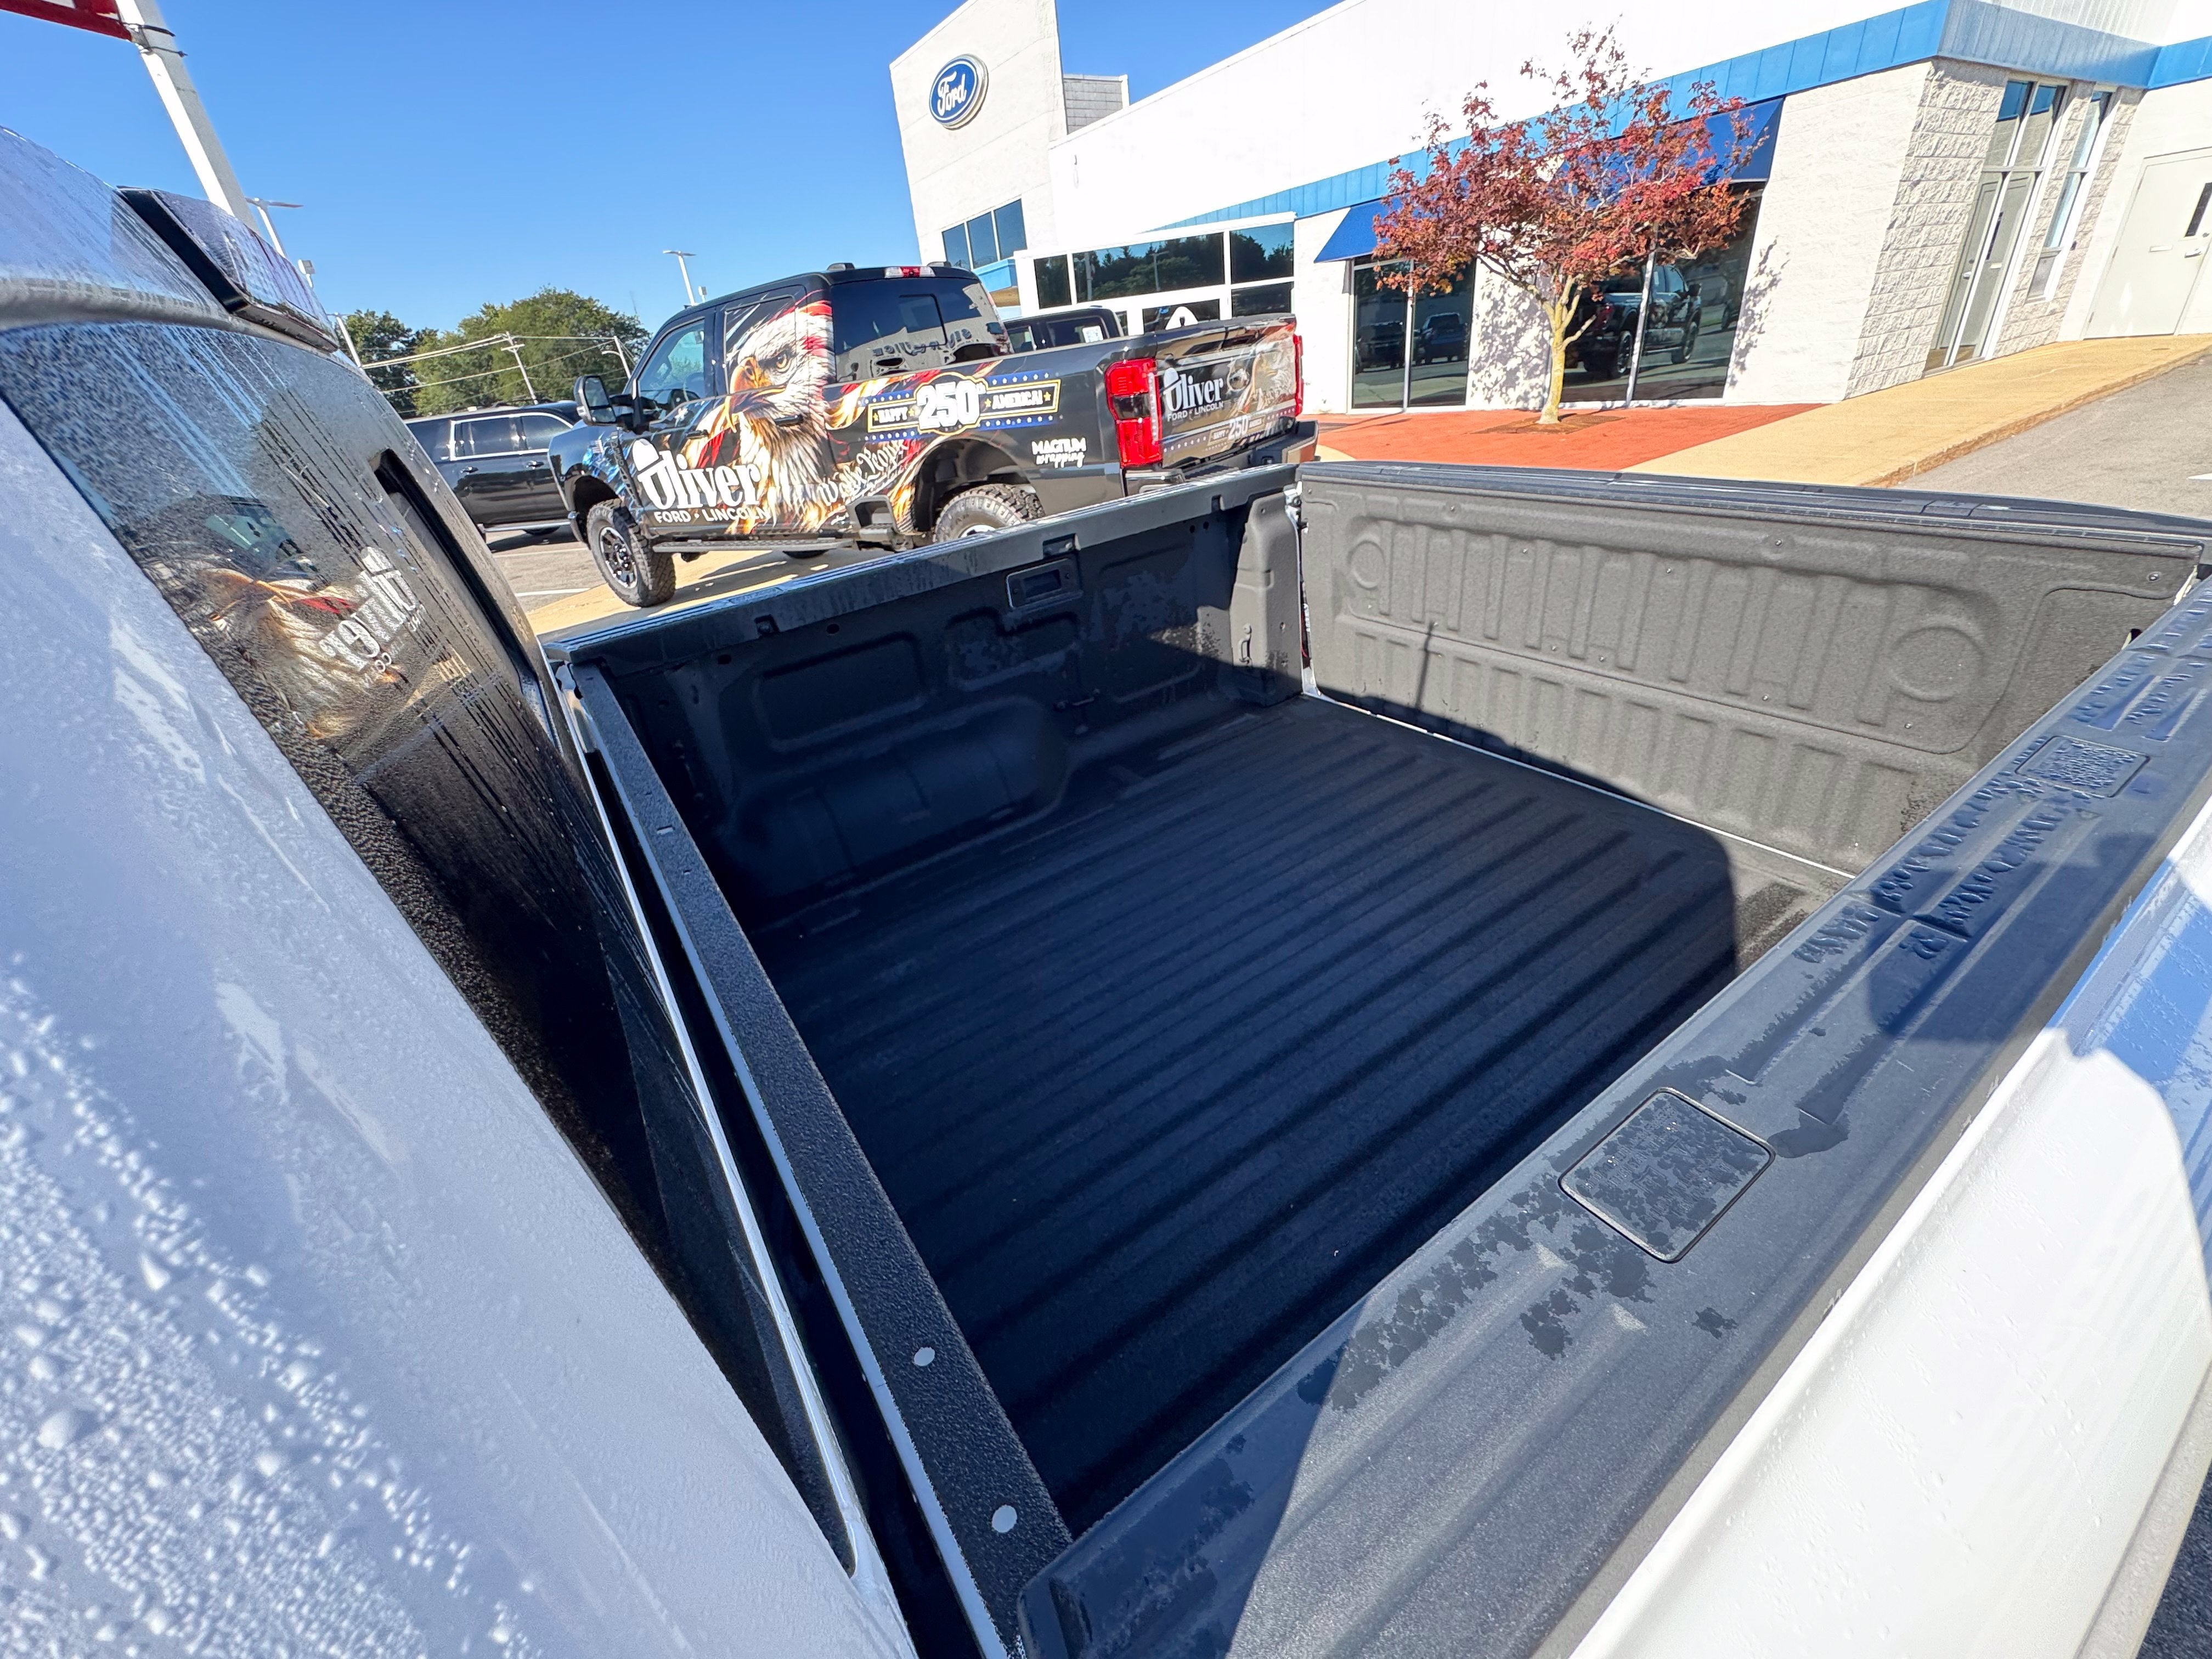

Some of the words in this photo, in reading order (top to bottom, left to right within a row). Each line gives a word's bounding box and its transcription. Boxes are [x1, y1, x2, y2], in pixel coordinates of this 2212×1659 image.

[937, 71, 967, 116] Ford
[1163, 367, 1224, 411] Oliver
[878, 407, 908, 423] HAPPY
[1167, 410, 1188, 422] FORD
[1194, 401, 1224, 415] LINCOLN
[1031, 437, 1087, 455] MAGNUM
[1036, 452, 1085, 469] wrapping
[632, 438, 761, 510] Oliver
[654, 510, 691, 523] FORD
[702, 506, 771, 522] LINCOLN
